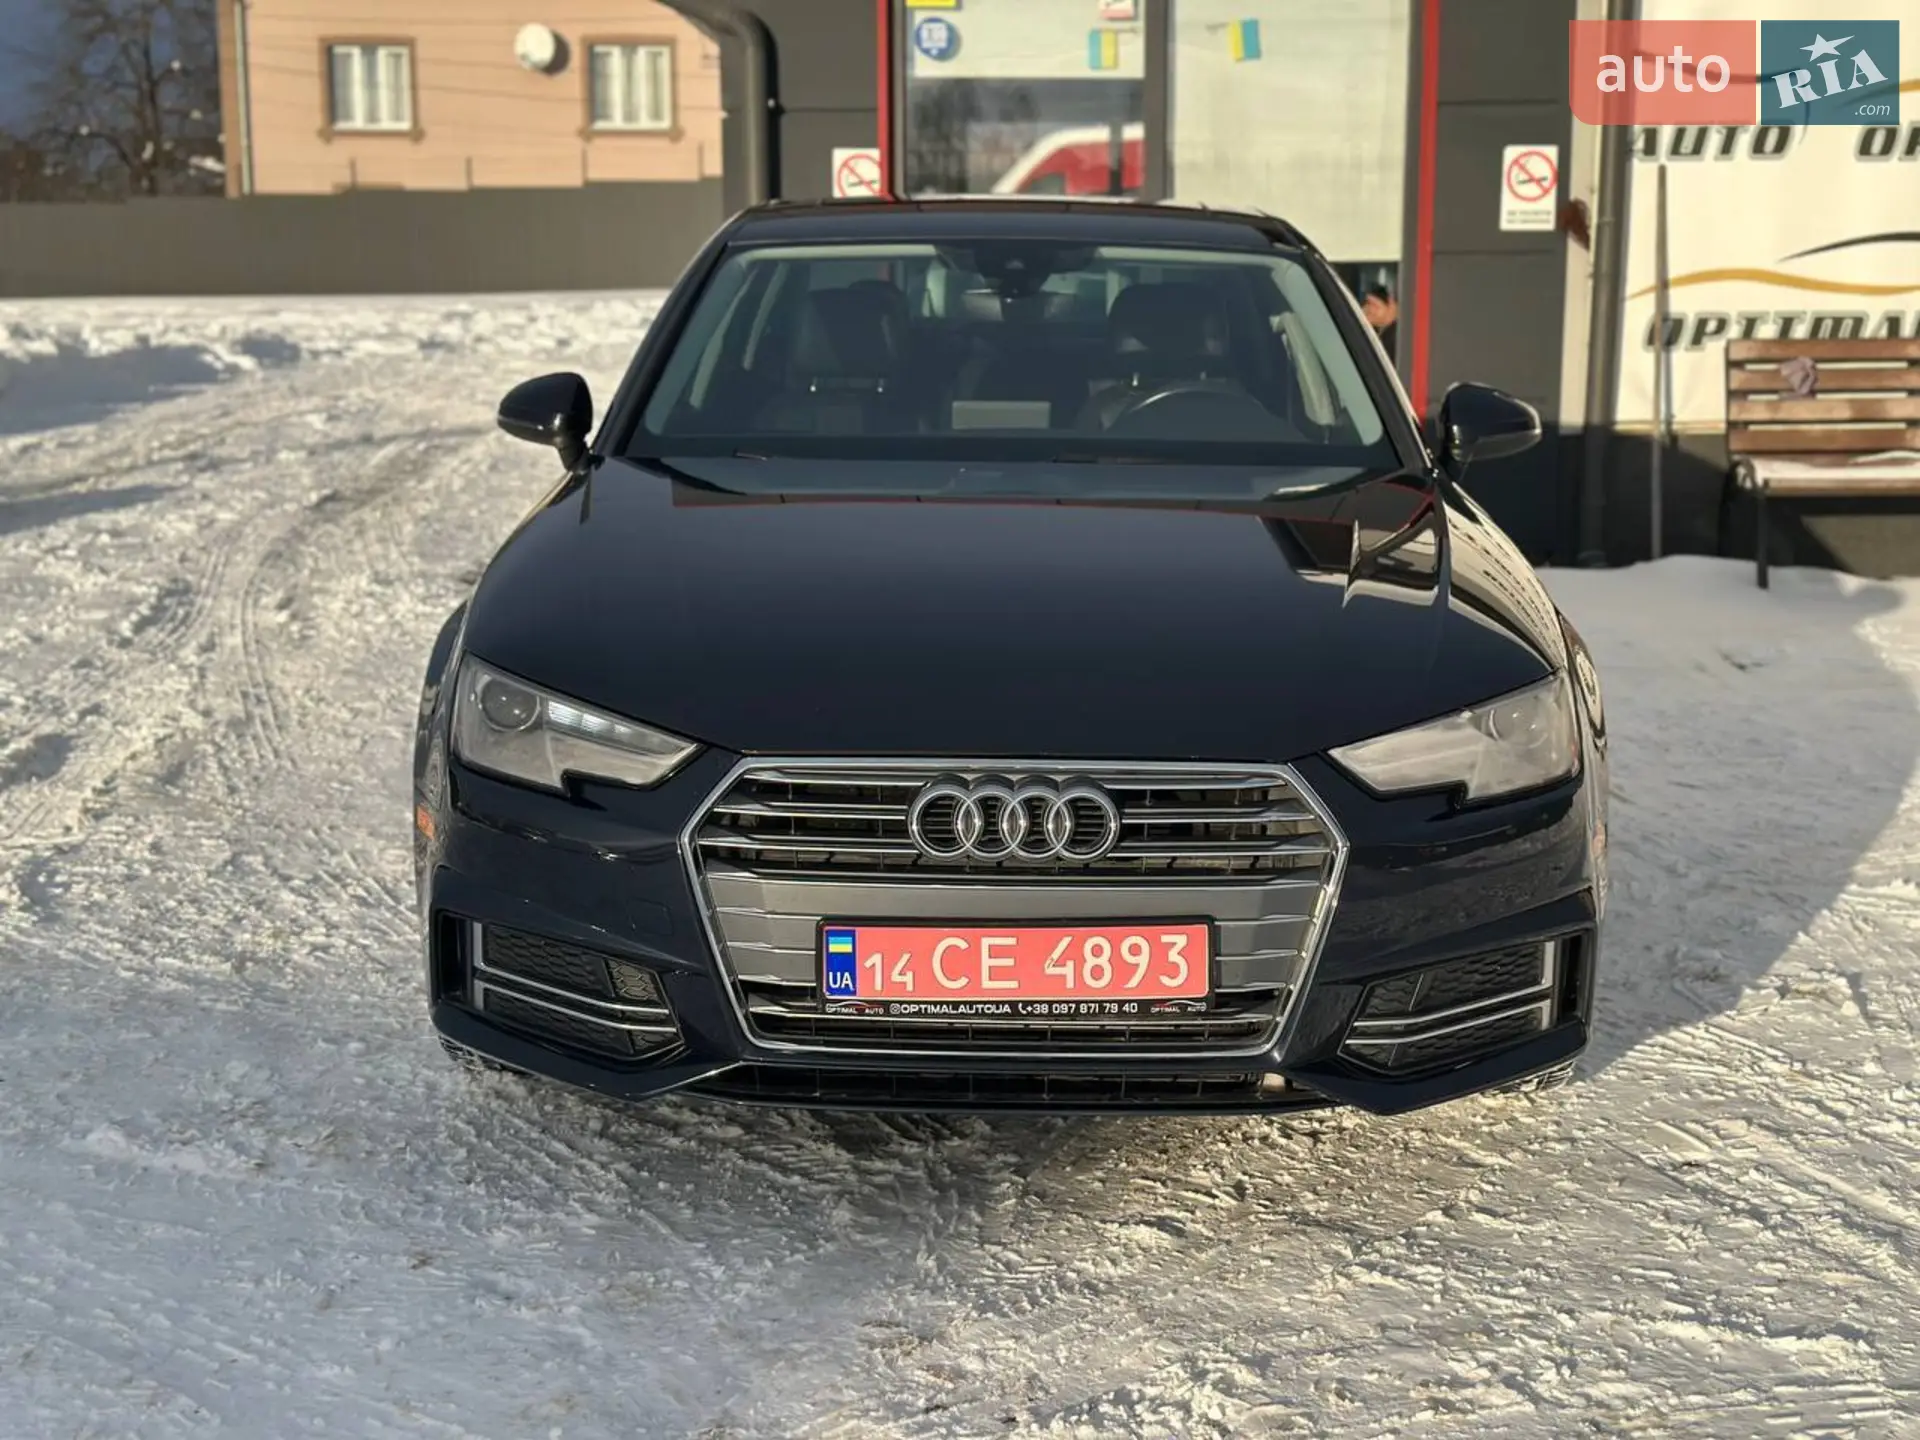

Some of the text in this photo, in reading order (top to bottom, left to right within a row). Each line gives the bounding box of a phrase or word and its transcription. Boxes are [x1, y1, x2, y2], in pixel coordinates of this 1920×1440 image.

[1643, 311, 1920, 352] OPTIMA
[863, 934, 1190, 992] 14 CE 4893
[829, 972, 853, 989] UA
[865, 1007, 884, 1015] AUTO
[1052, 1003, 1075, 1014] 097
[1079, 1003, 1099, 1013] 871
[1122, 1002, 1138, 1013] 40
